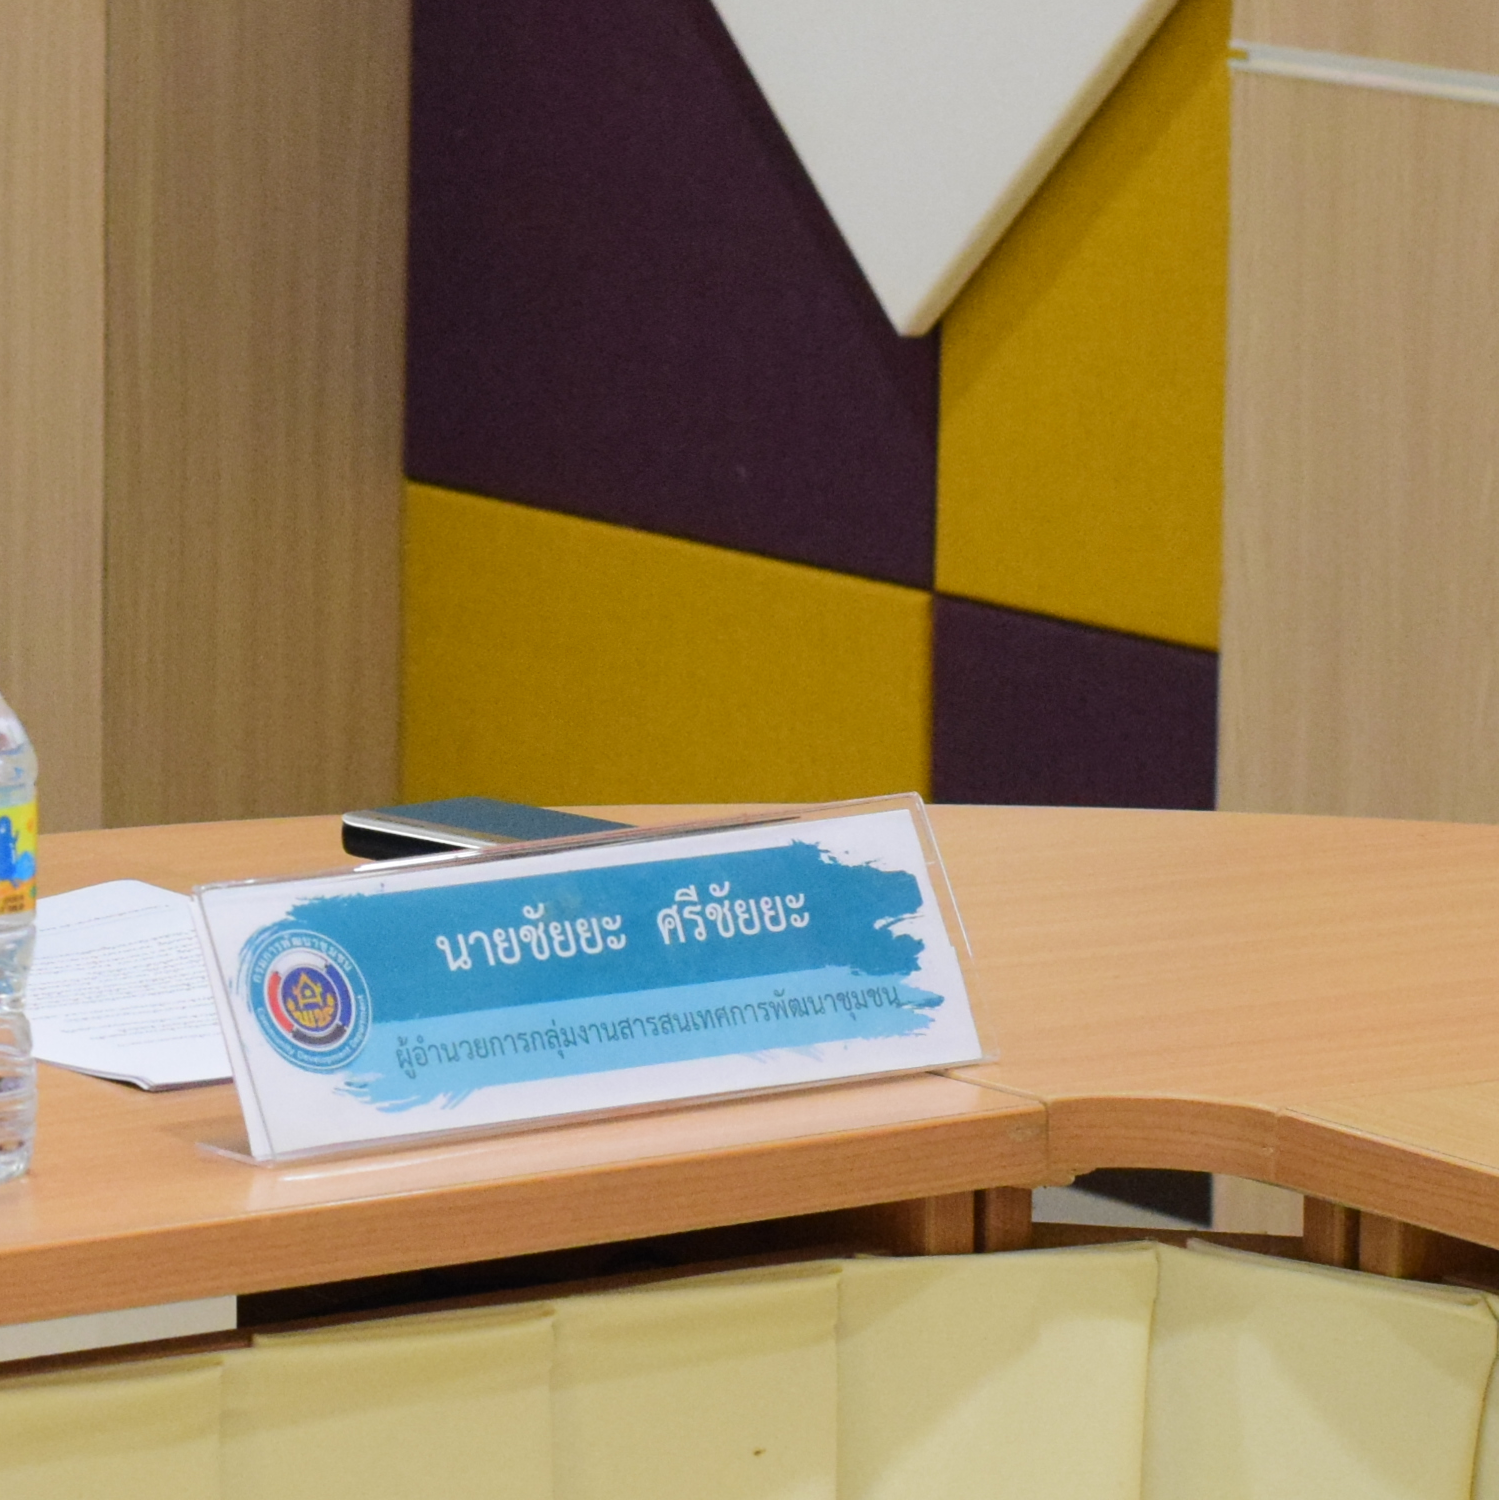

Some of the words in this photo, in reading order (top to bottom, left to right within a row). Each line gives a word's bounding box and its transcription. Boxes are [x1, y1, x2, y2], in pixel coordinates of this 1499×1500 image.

[435, 902, 627, 972] นายชัยยะ
[655, 880, 811, 946] ศรีชัยยะ
[395, 985, 903, 1080] ผู้อำนวยการกลุ่มงานสารสนเทศการพัฒนาชุมชน
